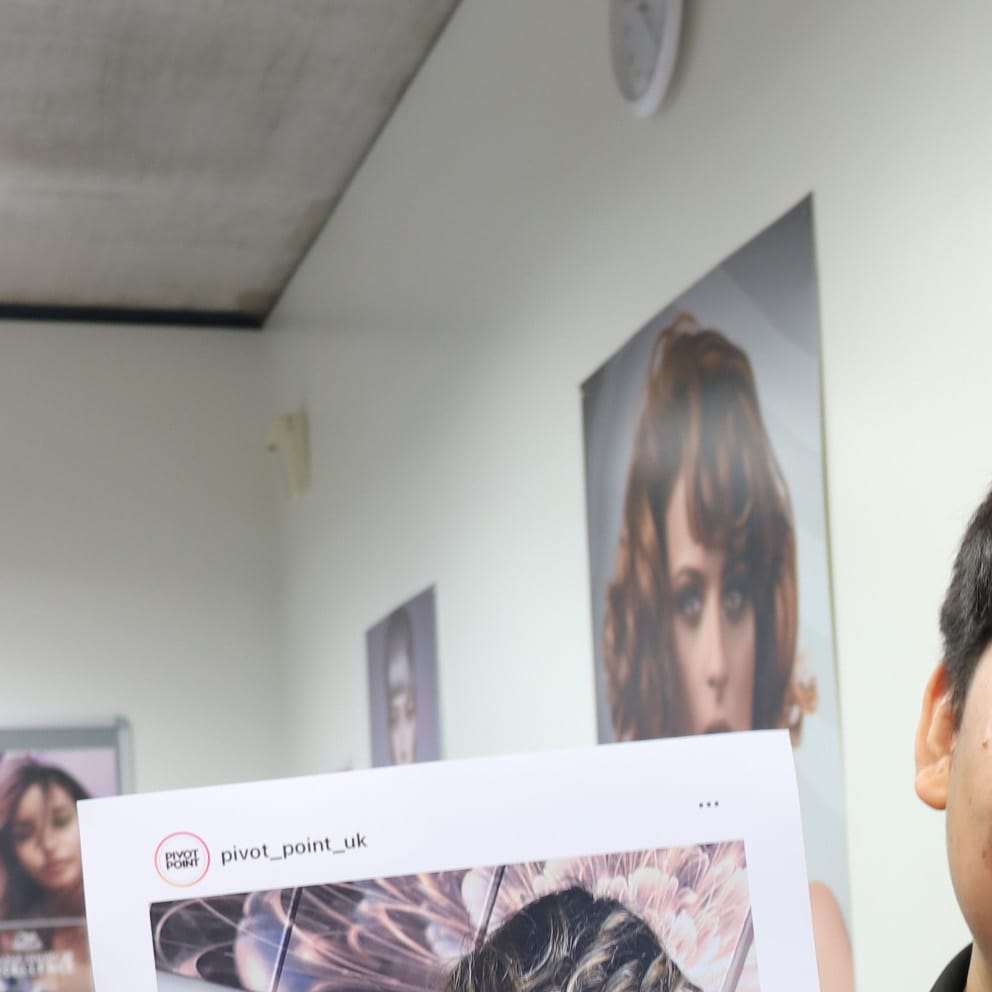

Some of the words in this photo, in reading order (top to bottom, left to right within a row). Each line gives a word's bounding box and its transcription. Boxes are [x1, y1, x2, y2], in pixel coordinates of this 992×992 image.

[220, 832, 367, 865] pivot_point_uk
[165, 849, 199, 861] PIVOT
[166, 858, 199, 870] POINT
